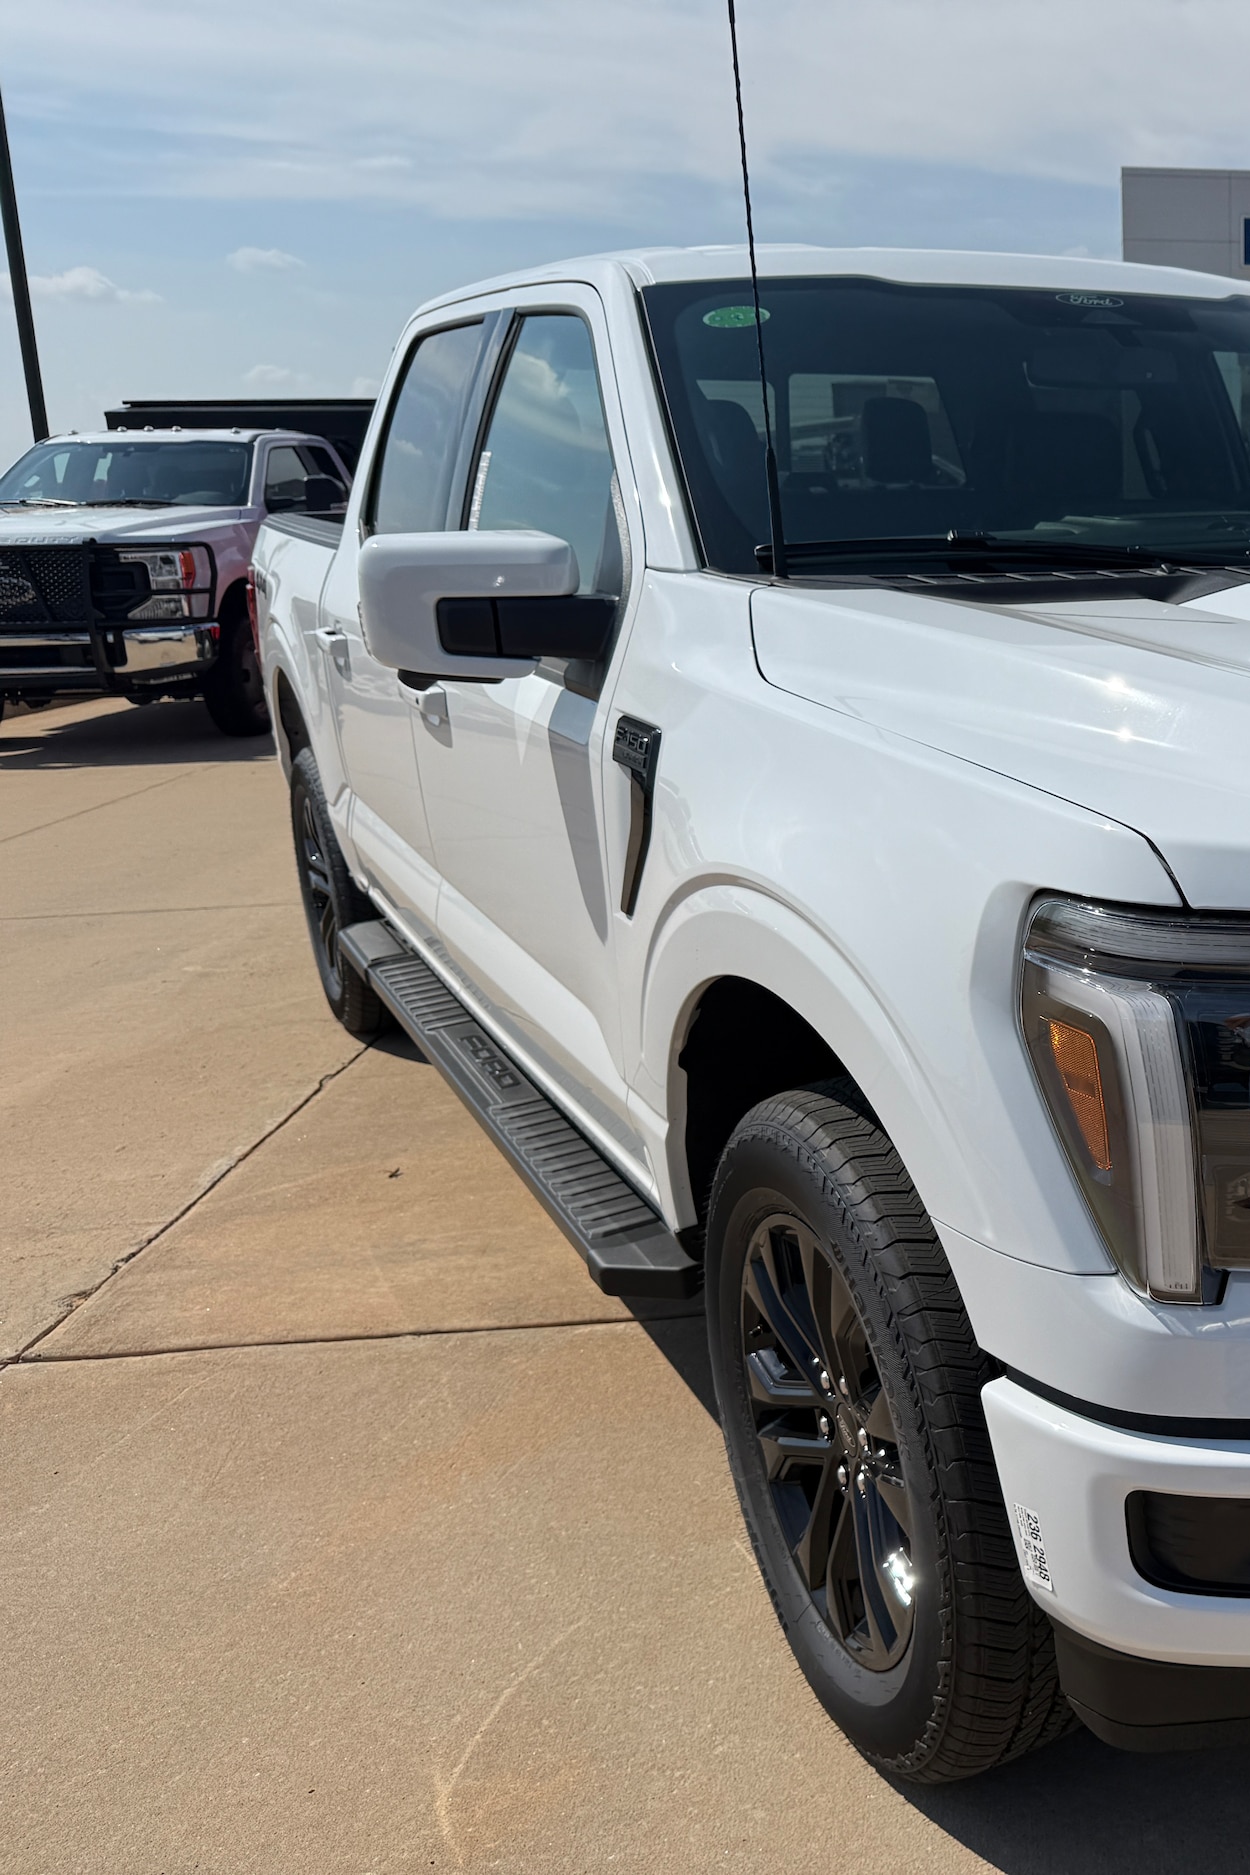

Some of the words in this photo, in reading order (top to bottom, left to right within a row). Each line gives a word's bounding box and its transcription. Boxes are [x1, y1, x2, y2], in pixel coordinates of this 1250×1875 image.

[1070, 294, 1113, 306] Ford
[459, 1035, 521, 1089] FORD
[1026, 1511, 1042, 1543] 236
[1033, 1544, 1050, 1582] 2948
